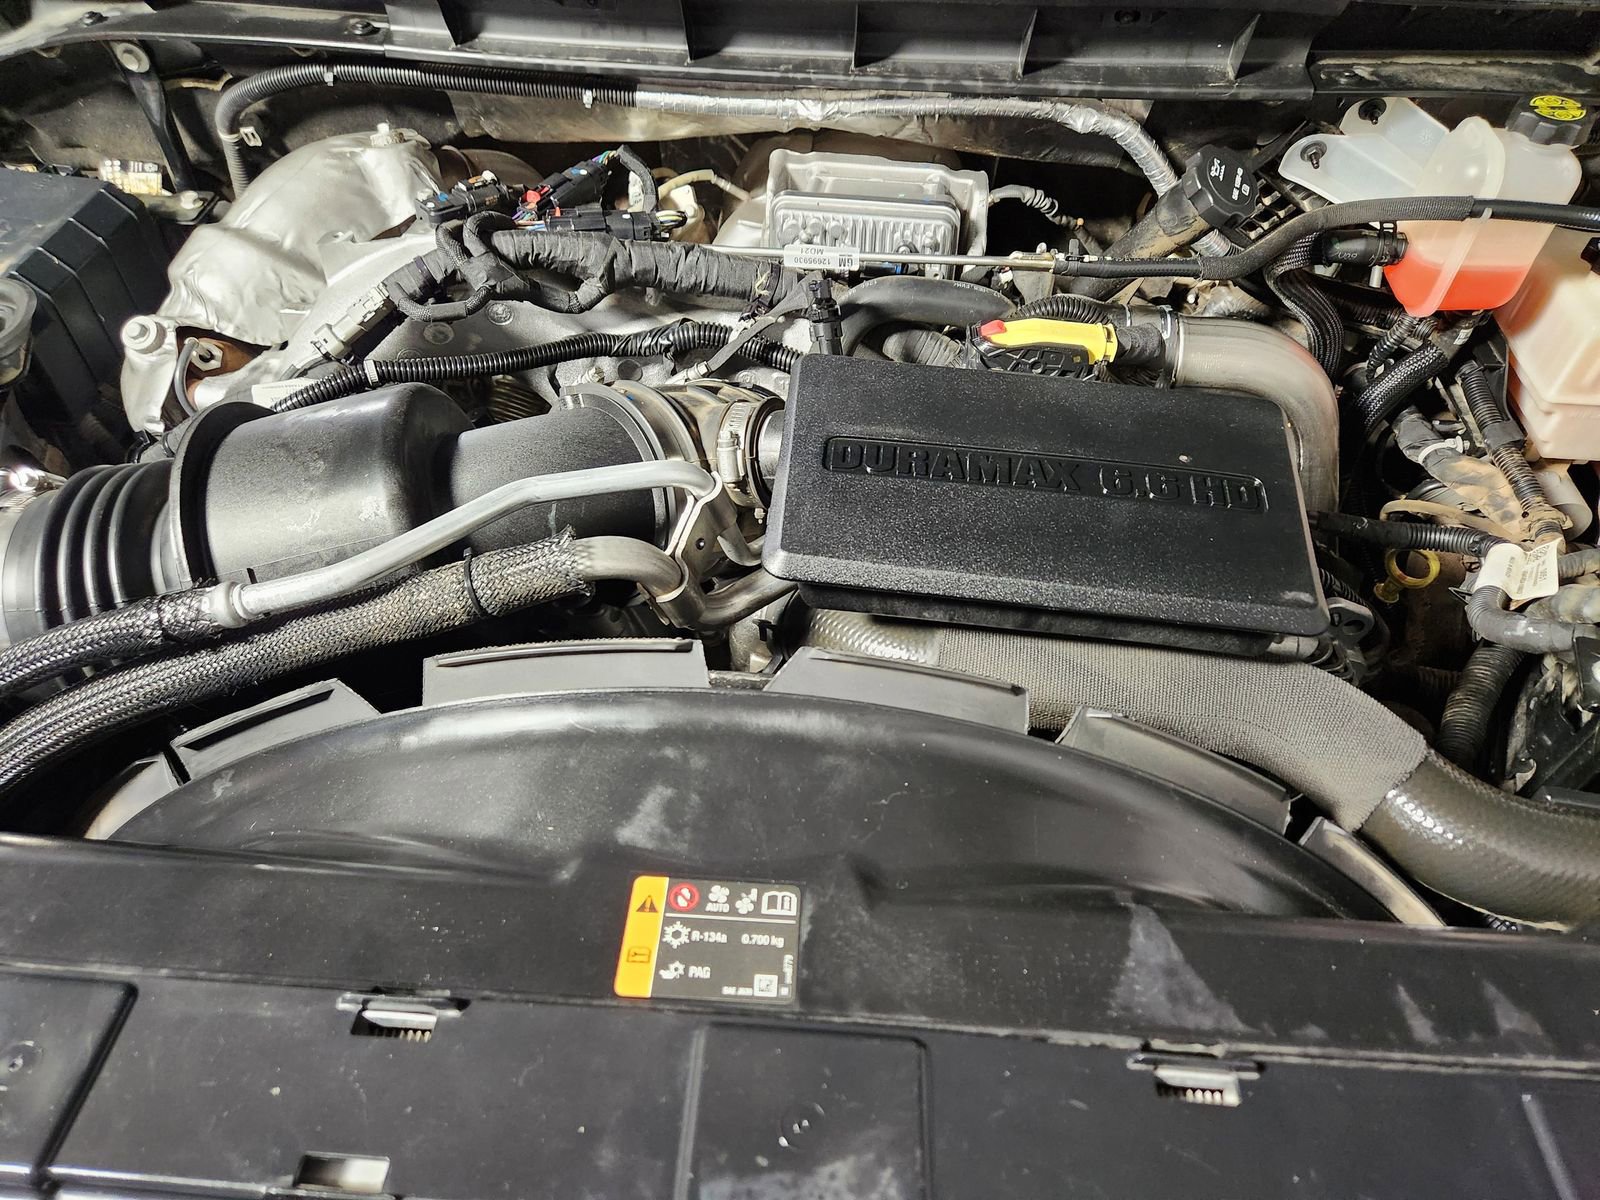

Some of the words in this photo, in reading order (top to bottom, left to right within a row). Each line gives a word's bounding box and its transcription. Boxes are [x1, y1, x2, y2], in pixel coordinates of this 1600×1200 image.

[800, 247, 824, 255] MD21
[794, 257, 831, 265] 12695930
[838, 255, 853, 267] GM
[829, 441, 1081, 491] DURAMAX
[1099, 466, 1180, 501] 6.6
[1189, 474, 1261, 511] HD
[705, 902, 730, 913] AUTO
[690, 930, 728, 944] R-134a
[741, 933, 771, 946] 0.700
[771, 935, 785, 948] kg
[687, 965, 711, 979] PAG
